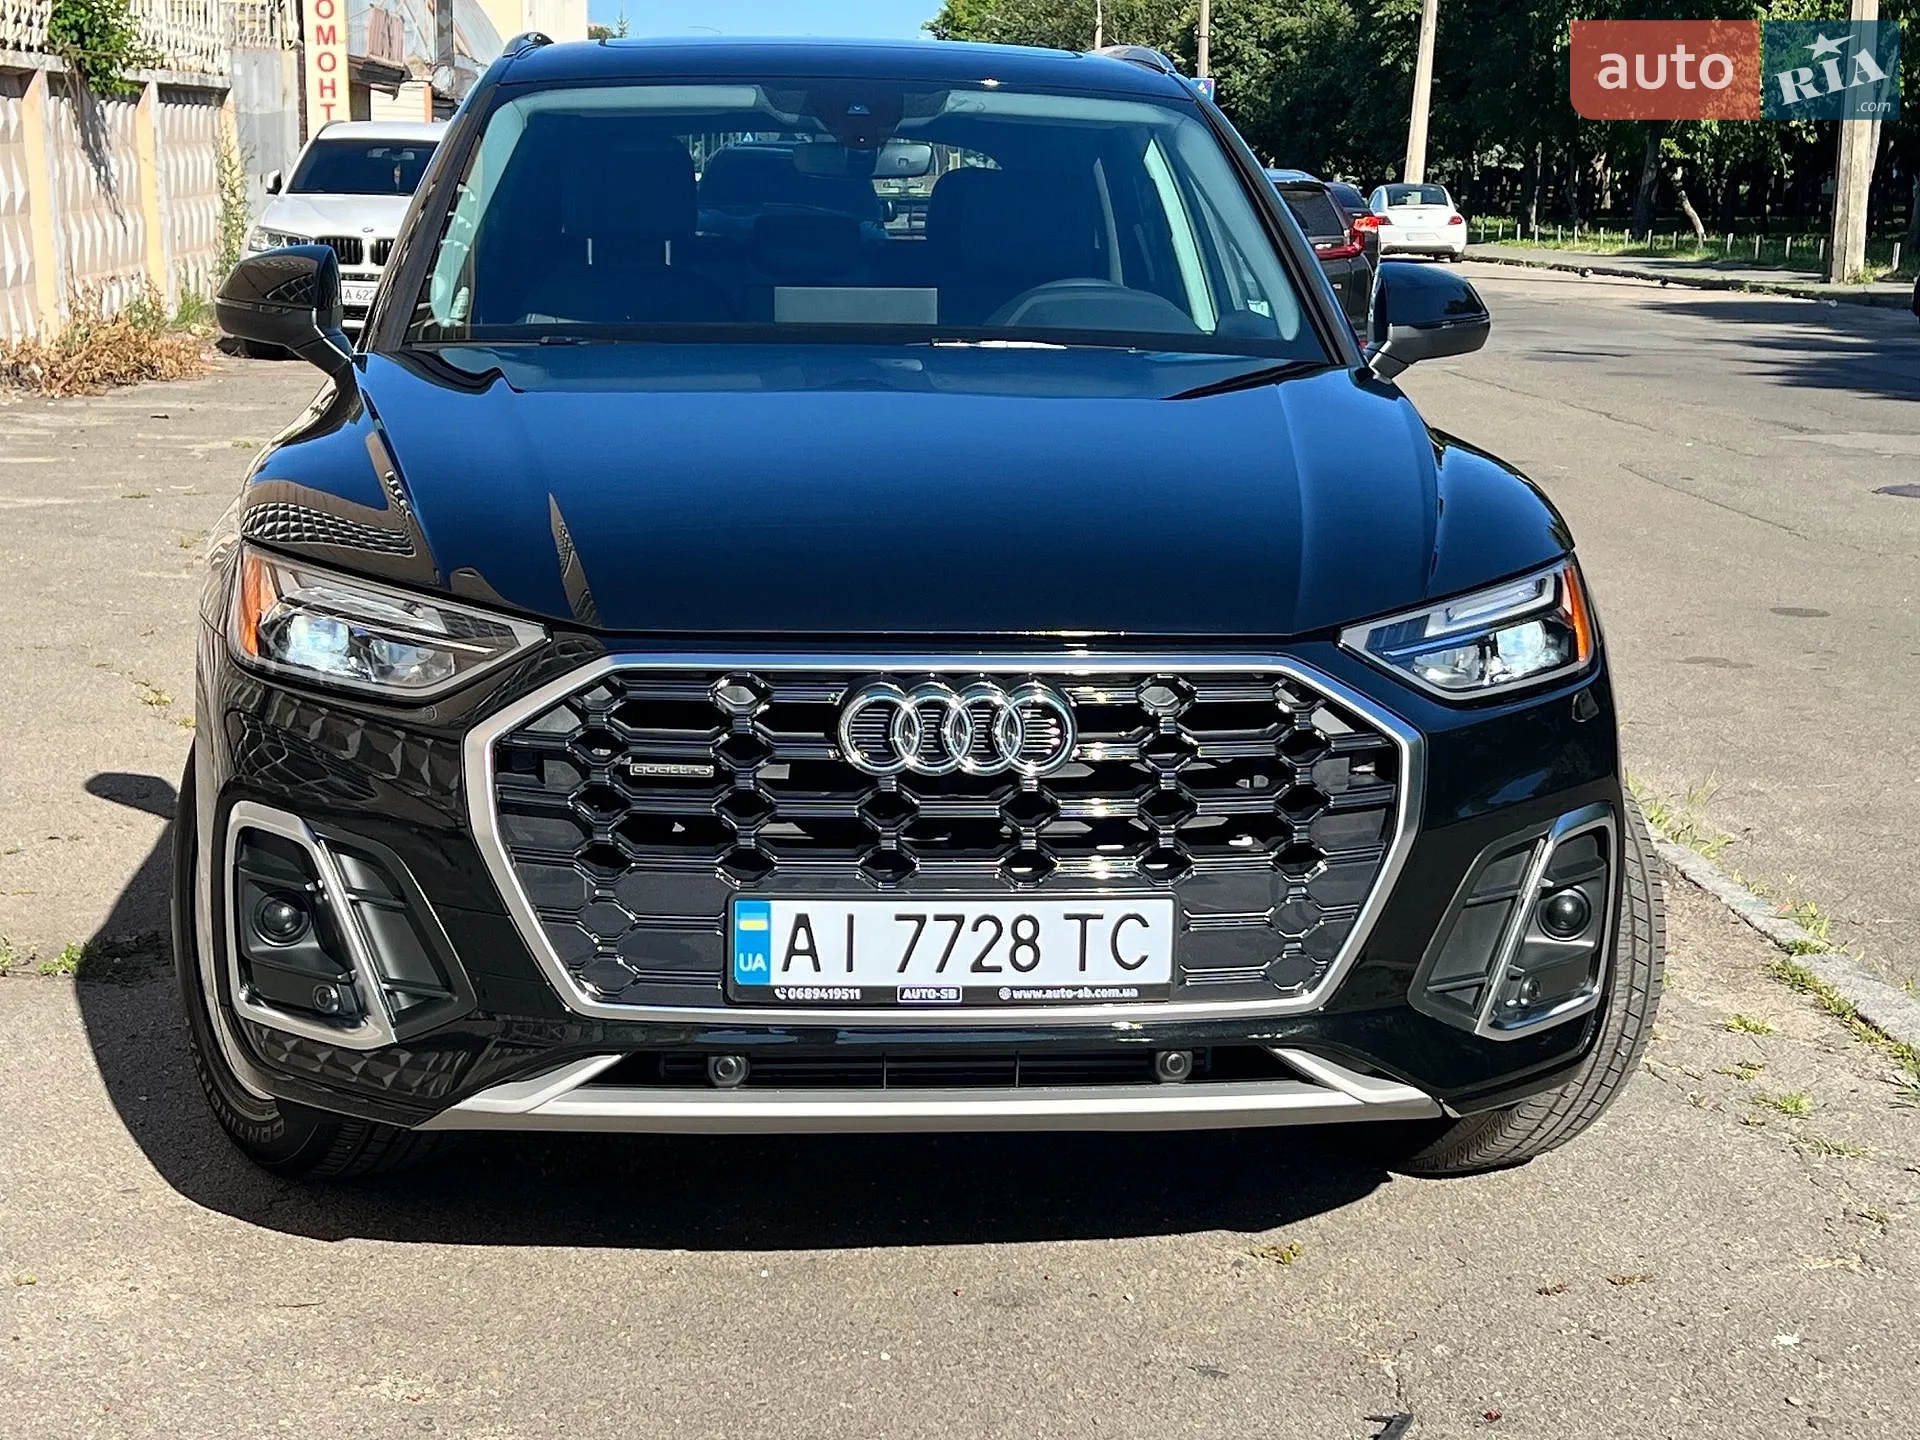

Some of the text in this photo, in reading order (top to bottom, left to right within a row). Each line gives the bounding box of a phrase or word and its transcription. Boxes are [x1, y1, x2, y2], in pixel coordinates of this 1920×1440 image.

[894, 913, 1041, 973] 7728
[1063, 912, 1150, 972] TC
[739, 954, 766, 972] UA
[787, 986, 1139, 1000] 0689419511 AUTO-SB www.auto-sb.com.ua
